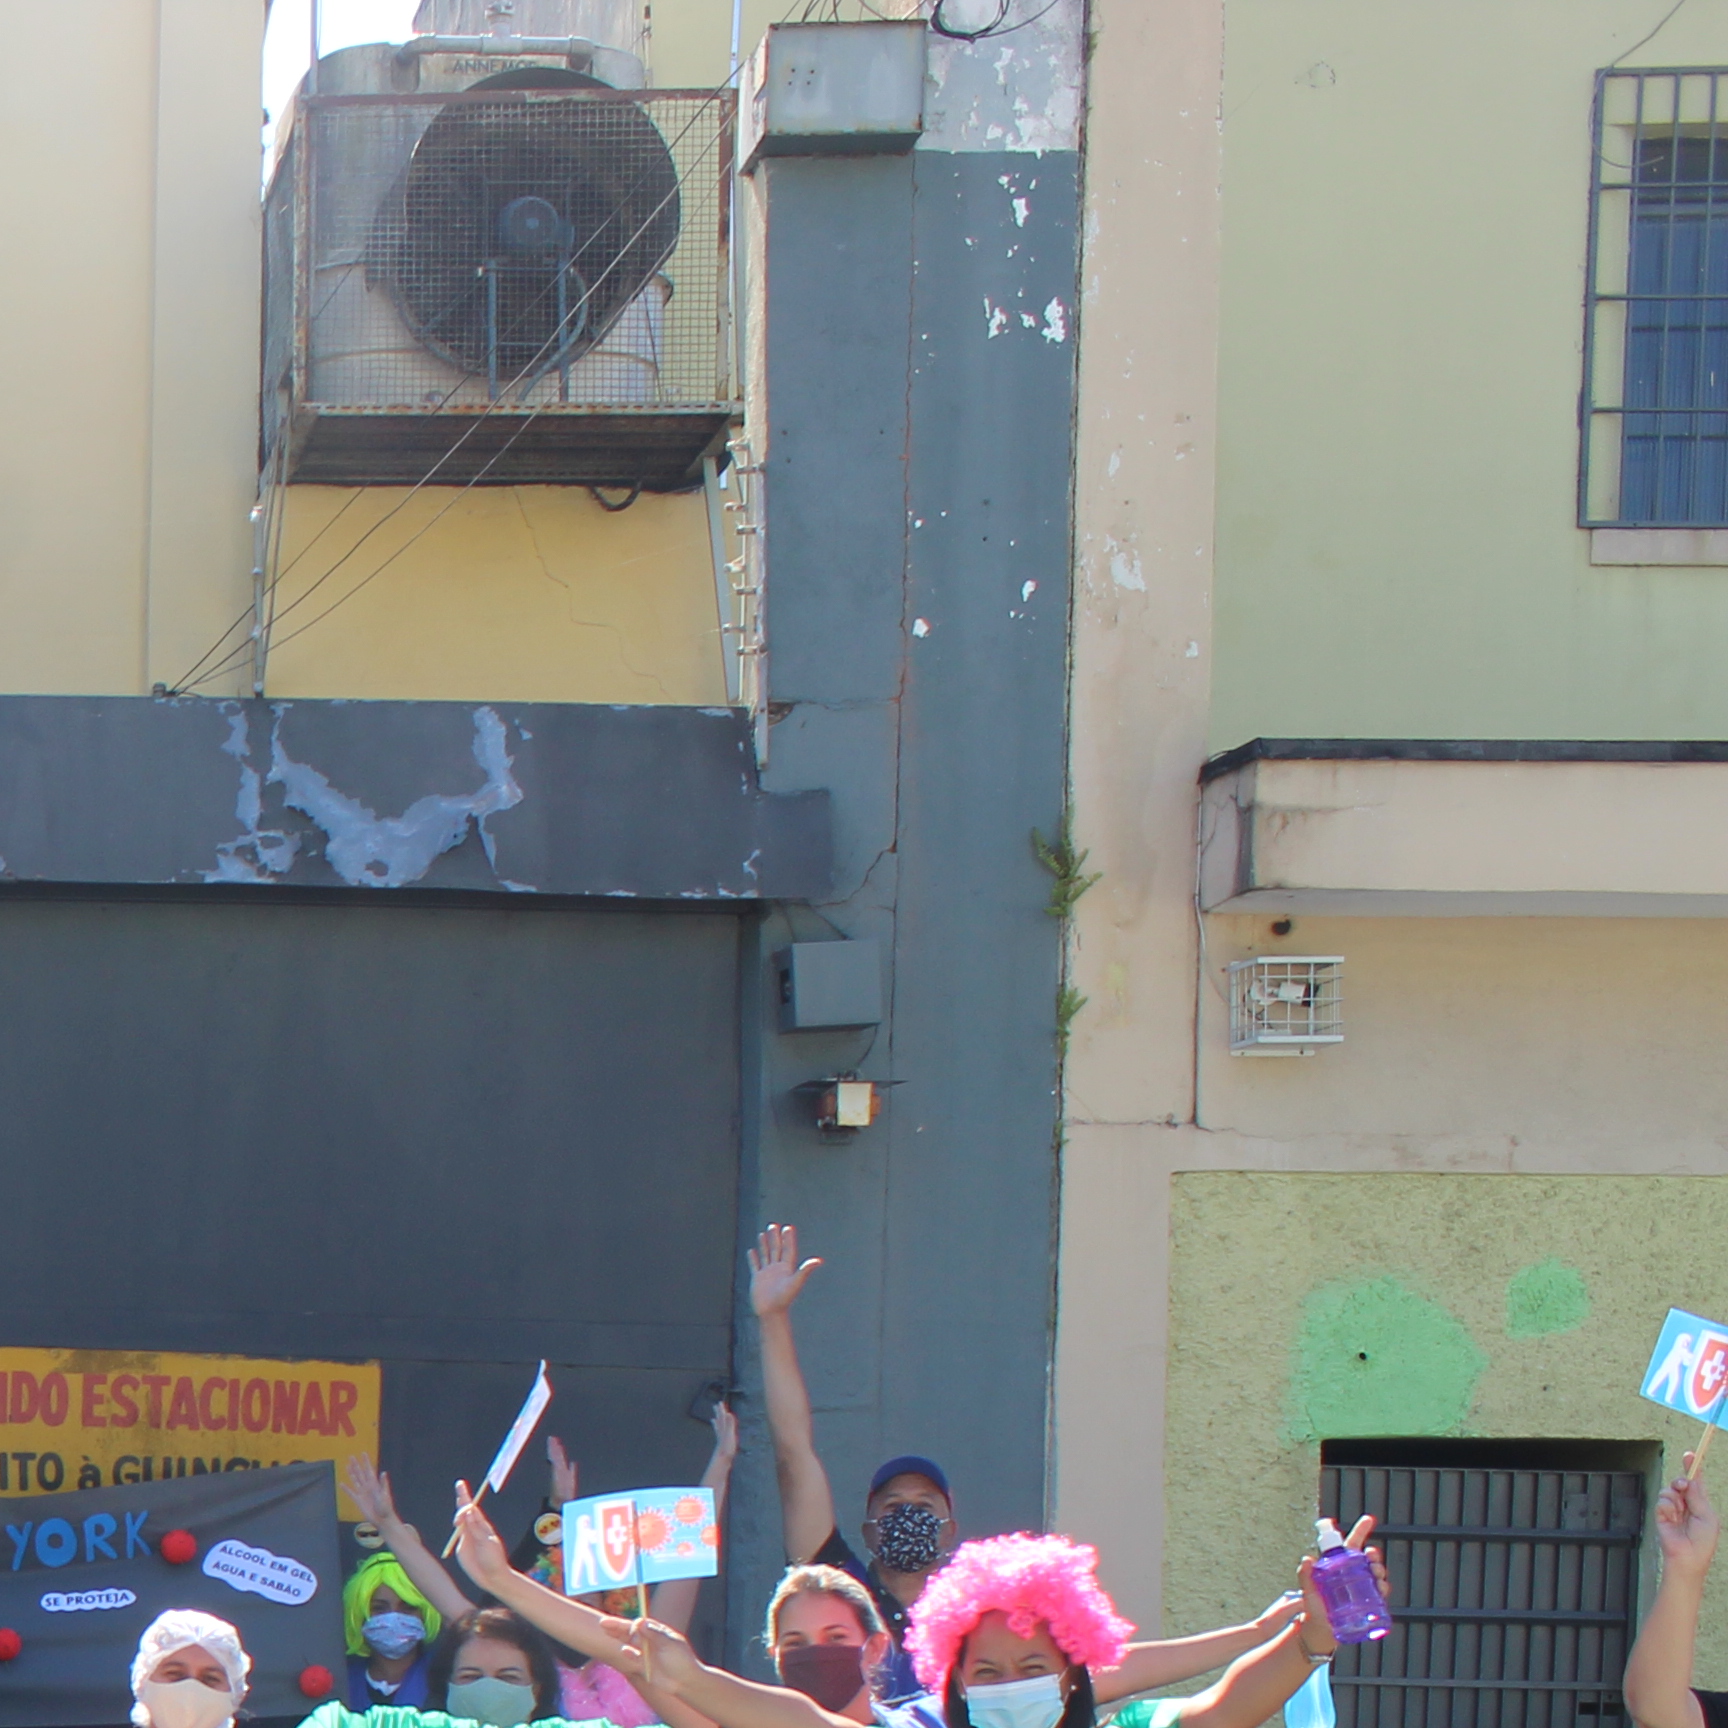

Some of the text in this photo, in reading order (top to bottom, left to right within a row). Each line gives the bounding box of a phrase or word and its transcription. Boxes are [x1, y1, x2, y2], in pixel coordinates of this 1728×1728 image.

[81, 1374, 359, 1438] ESTACIONAR
[77, 1455, 102, 1490] à
[5, 1511, 152, 1572] YORK
[250, 1573, 258, 1581] E
[260, 1576, 301, 1597] SABÃO
[270, 1561, 288, 1572] EM
[290, 1568, 314, 1583] GEL
[45, 1592, 130, 1606] SE PROTEJA
